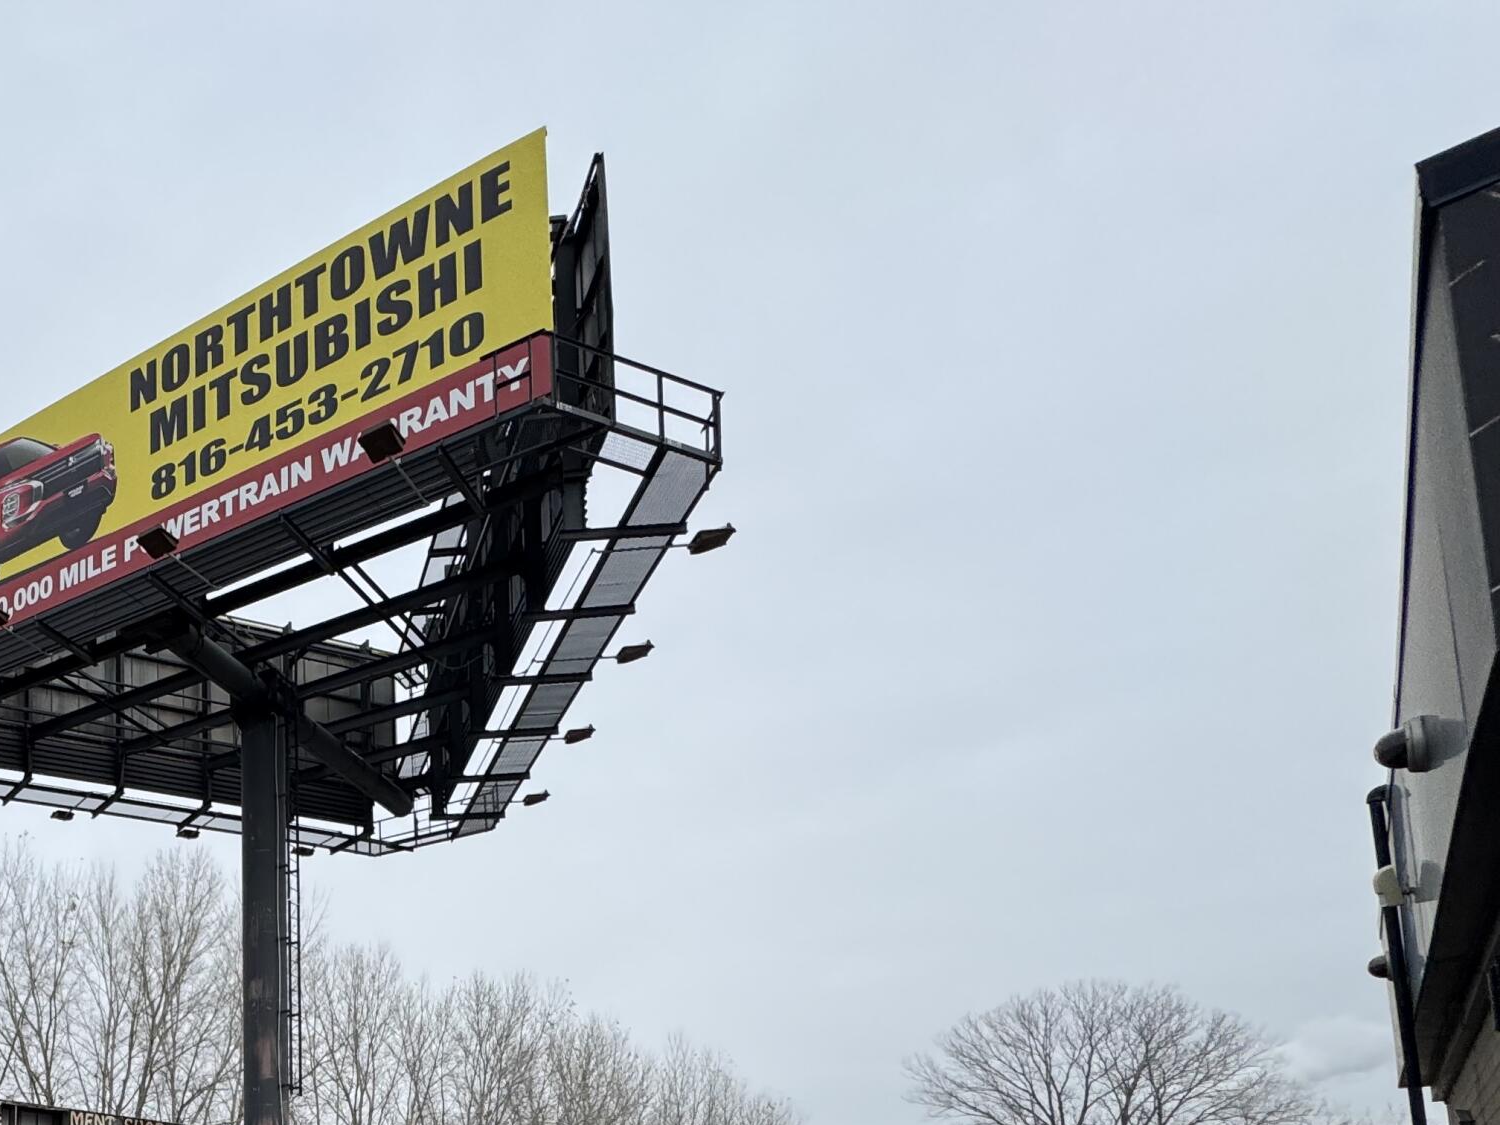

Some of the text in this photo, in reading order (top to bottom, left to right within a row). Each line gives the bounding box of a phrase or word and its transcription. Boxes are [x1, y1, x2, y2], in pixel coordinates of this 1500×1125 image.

[129, 160, 513, 413] NORTHTOWNE
[149, 238, 483, 456] MITSUBISHI
[59, 543, 117, 592] MILE
[123, 454, 313, 563] PWERTRAIN
[320, 356, 530, 474] WARANTY
[150, 311, 485, 501] 816-453-2710
